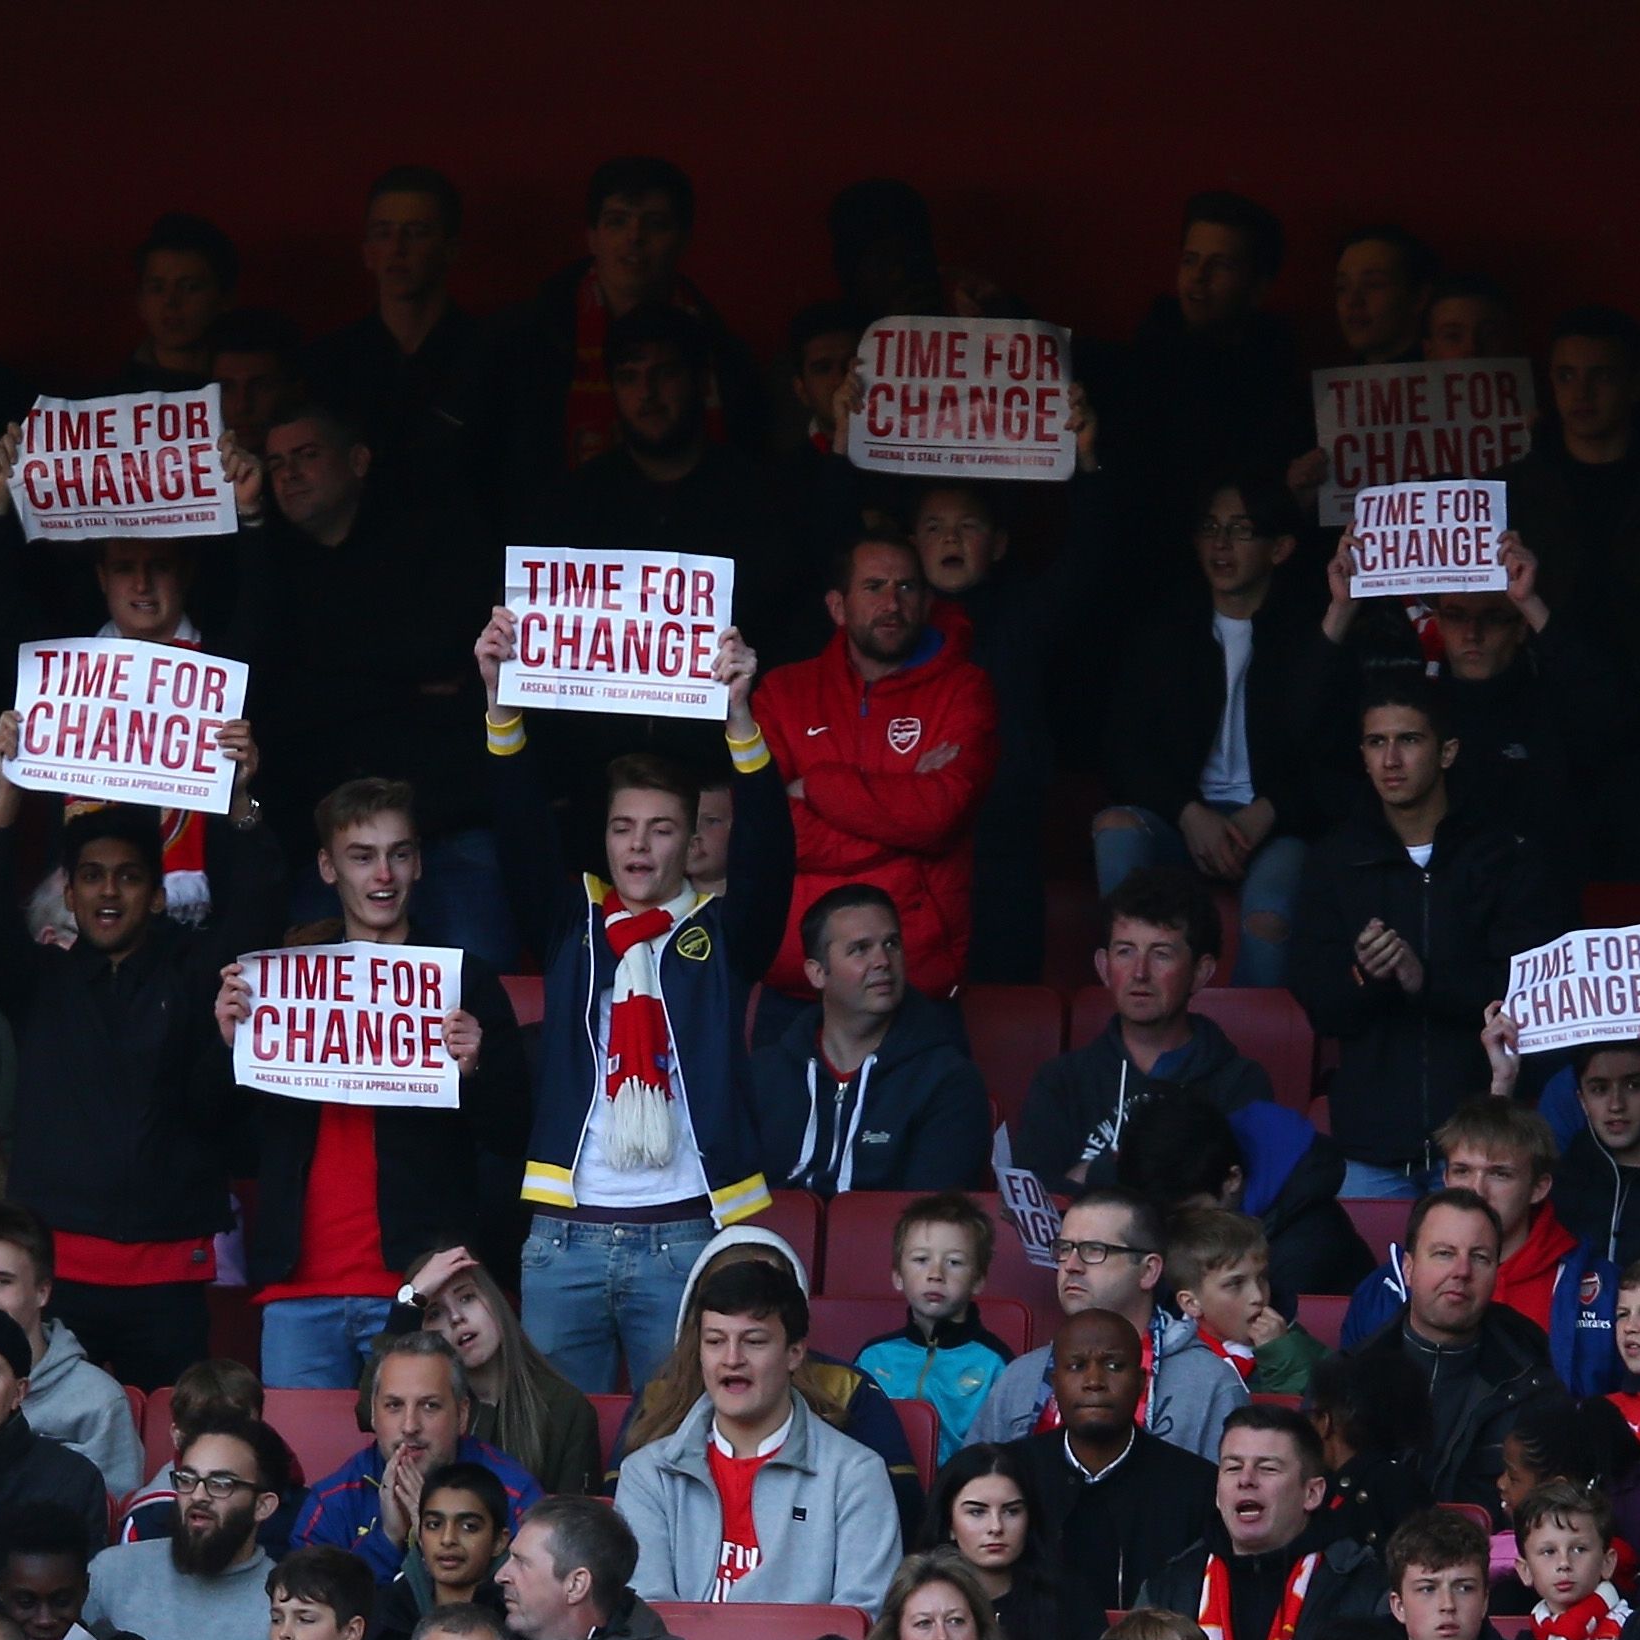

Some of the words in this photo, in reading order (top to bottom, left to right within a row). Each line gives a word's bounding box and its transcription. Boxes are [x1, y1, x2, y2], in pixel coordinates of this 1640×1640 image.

[875, 331, 969, 380] TIME
[985, 334, 1060, 382] FOR
[869, 384, 1059, 442] CHANGE
[1331, 377, 1429, 427] TIME
[1445, 372, 1520, 421] FOR
[27, 410, 117, 453] TIME
[135, 403, 210, 446] FOR
[26, 441, 215, 509] CHANGE
[1365, 494, 1425, 525] TIME
[1439, 491, 1490, 522] FOR
[1356, 529, 1491, 571] CHANGE
[525, 563, 623, 610] TIME
[642, 567, 714, 616] FOR
[523, 609, 714, 679] CHANGE
[37, 652, 131, 700] TIME
[149, 660, 227, 712] FOR
[27, 698, 221, 773] CHANGE
[254, 954, 355, 1003] TIME
[372, 960, 442, 1009] FOR
[1515, 939, 1574, 986] TIME
[249, 1003, 448, 1068] CHANGE
